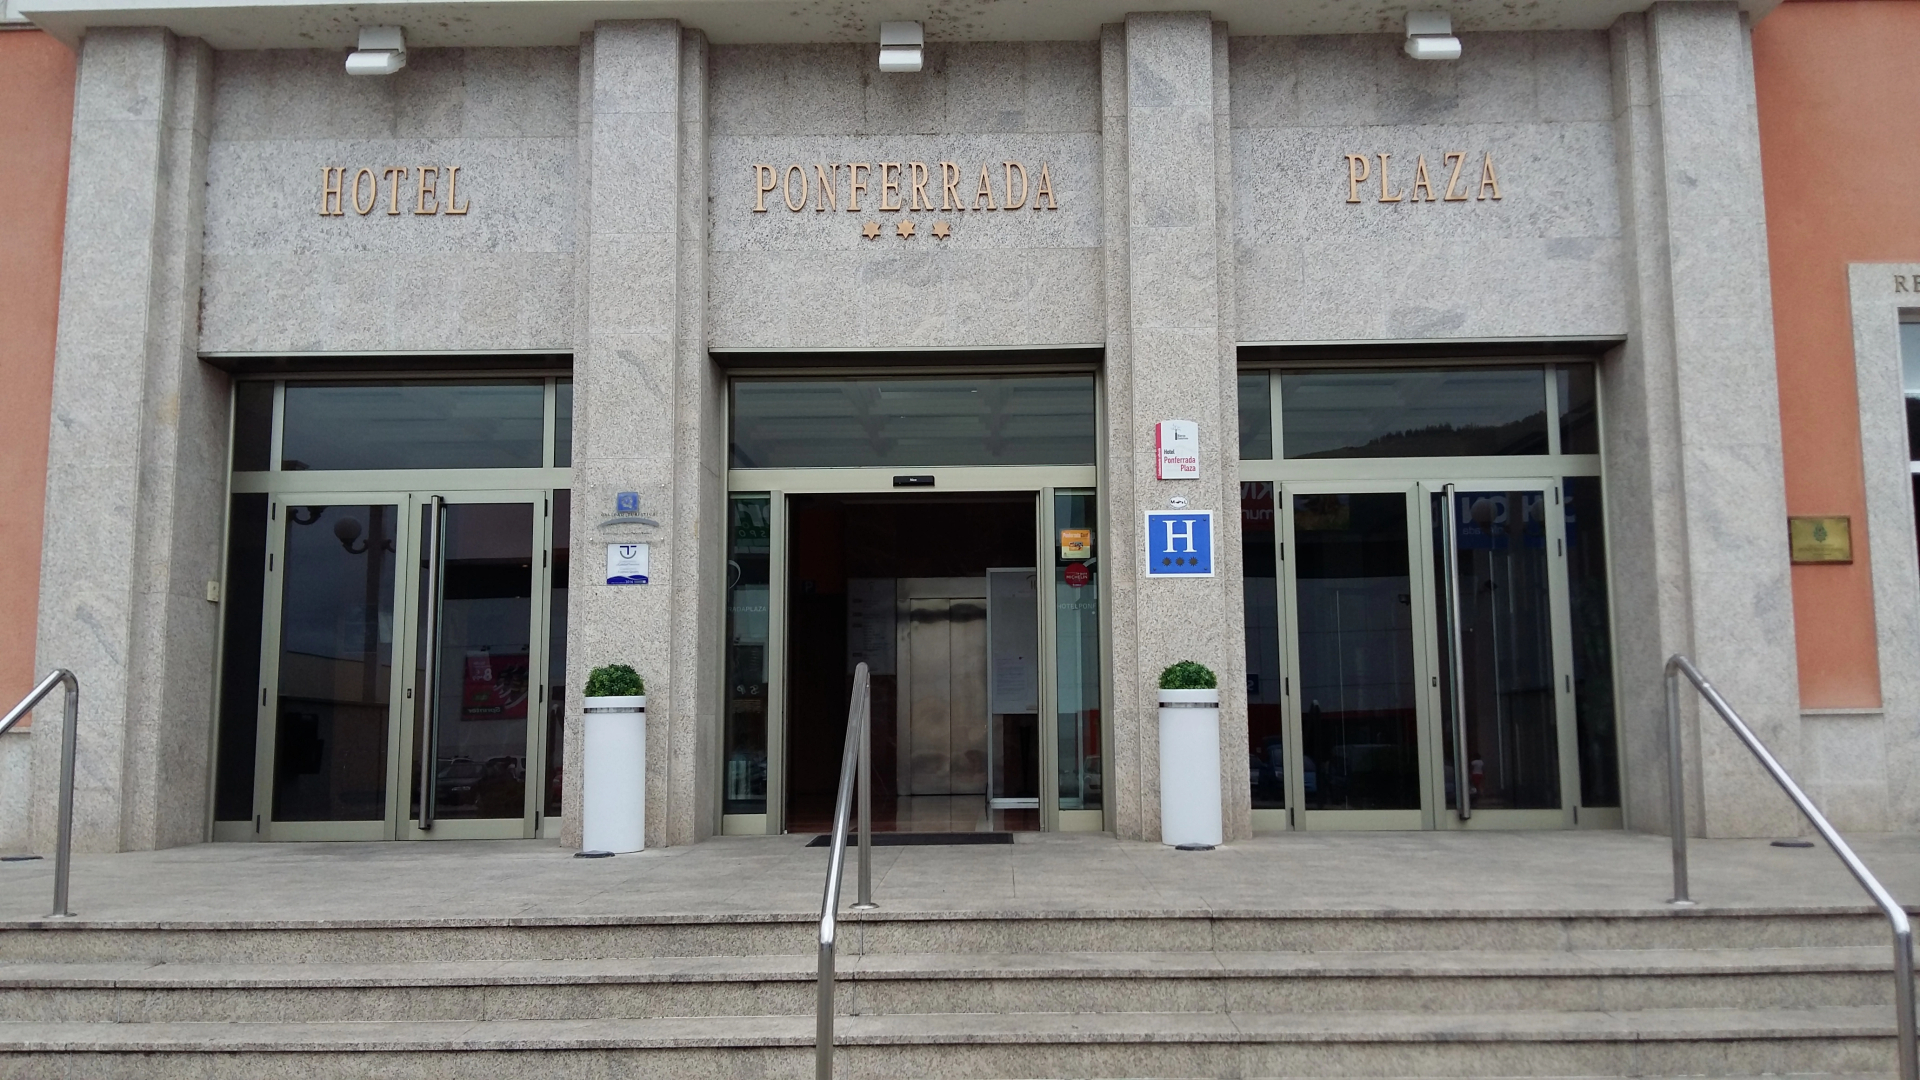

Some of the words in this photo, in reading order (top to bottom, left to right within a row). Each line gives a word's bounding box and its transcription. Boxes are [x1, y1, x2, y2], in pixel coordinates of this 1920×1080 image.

[318, 165, 471, 217] HOTEL
[752, 160, 1059, 213] PONFERRADA
[1344, 151, 1503, 204] PLAZA
[1163, 456, 1196, 464] Ponferrada
[1180, 464, 1196, 472] Plaza
[1162, 520, 1197, 553] H
